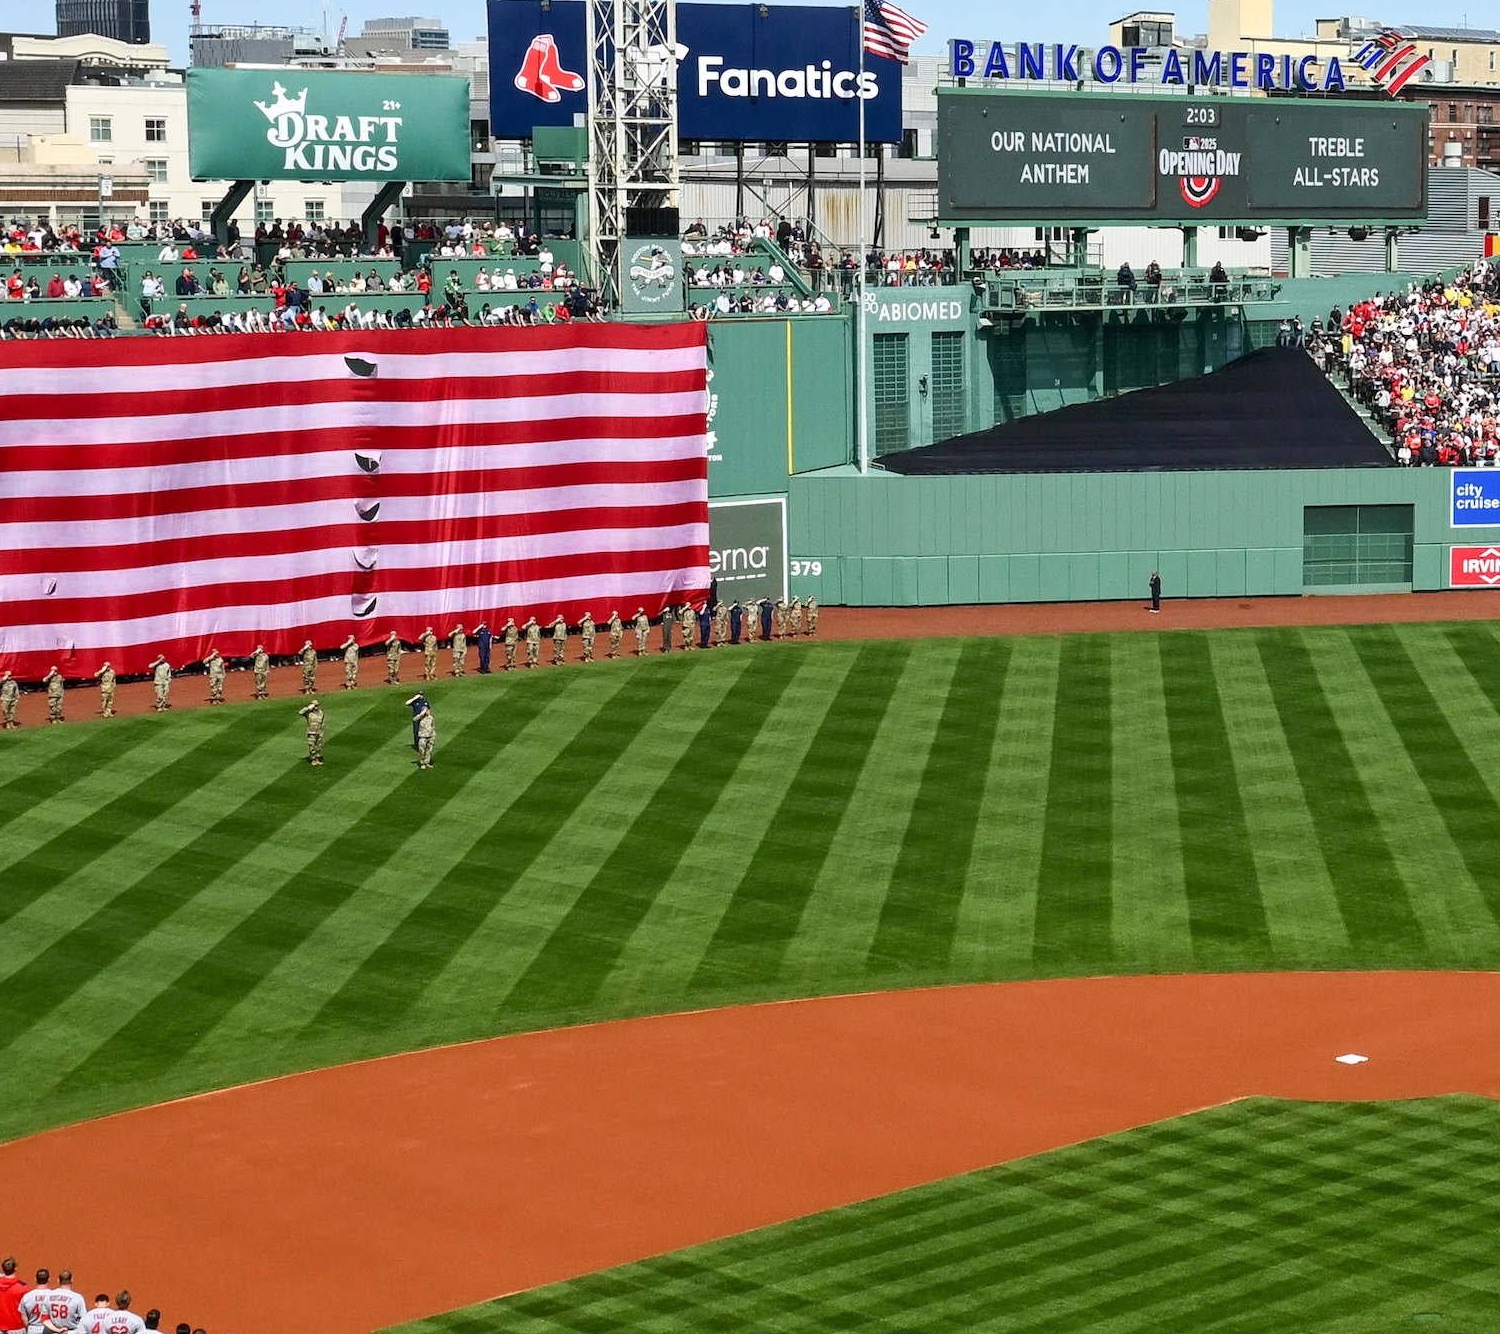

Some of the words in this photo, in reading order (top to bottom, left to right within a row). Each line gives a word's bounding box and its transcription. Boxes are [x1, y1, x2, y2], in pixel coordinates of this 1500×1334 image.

[948, 38, 1080, 80] BANK
[1091, 45, 1149, 84] OF
[1160, 48, 1347, 92] AMERICA
[698, 56, 879, 99] Fanatics
[382, 99, 402, 111] 21+
[1186, 107, 1216, 124] 2:03
[266, 112, 402, 147] DRAFT
[991, 132, 1025, 152] OUR
[1031, 132, 1116, 154] NATIONAL
[1200, 138, 1217, 150] 2025
[1309, 137, 1365, 157] TREBLE
[283, 141, 399, 172] KINGS
[1159, 148, 1216, 176] OPENING
[1215, 150, 1241, 176] DAY
[1020, 163, 1089, 185] ANTHEM
[1293, 167, 1379, 188] ALL-STARS
[879, 302, 961, 322] ABIOMED
[1456, 483, 1483, 499] city
[790, 560, 822, 576] 379
